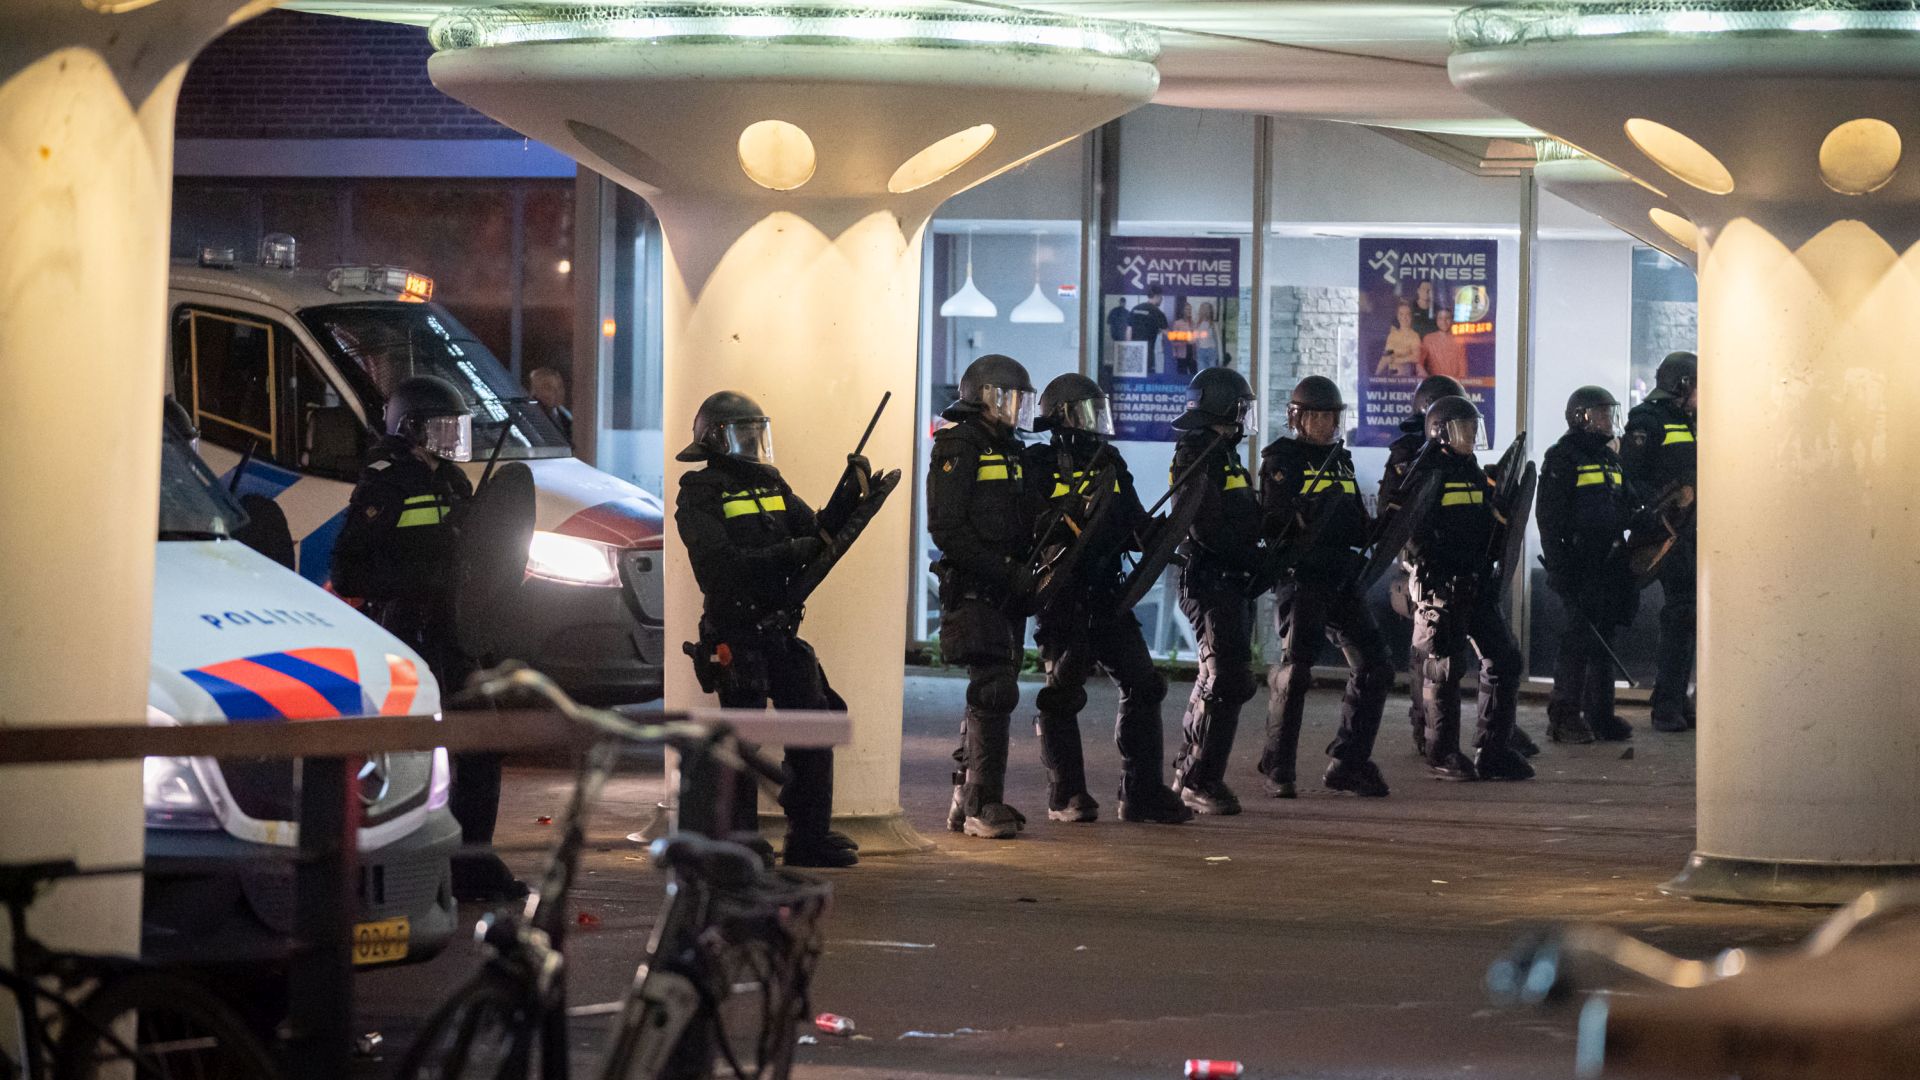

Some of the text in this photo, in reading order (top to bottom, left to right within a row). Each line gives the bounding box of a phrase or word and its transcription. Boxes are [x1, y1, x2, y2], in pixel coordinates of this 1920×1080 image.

[1401, 252, 1486, 266] ANYTIME
[1147, 259, 1232, 272] ANYTIME
[1400, 267, 1486, 280] FITNESS
[1146, 273, 1232, 287] FITNESS
[1133, 383, 1144, 392] JE
[1113, 393, 1139, 402] SCAN
[1141, 393, 1153, 402] DE
[1366, 391, 1388, 400] WIJ
[1132, 403, 1182, 412] AFSPRAAK
[1366, 403, 1381, 413] EN
[1382, 404, 1394, 413] JE
[1120, 413, 1153, 422] DAGEN
[1366, 416, 1400, 426] WAAR
[200, 608, 335, 630] POLITIE
